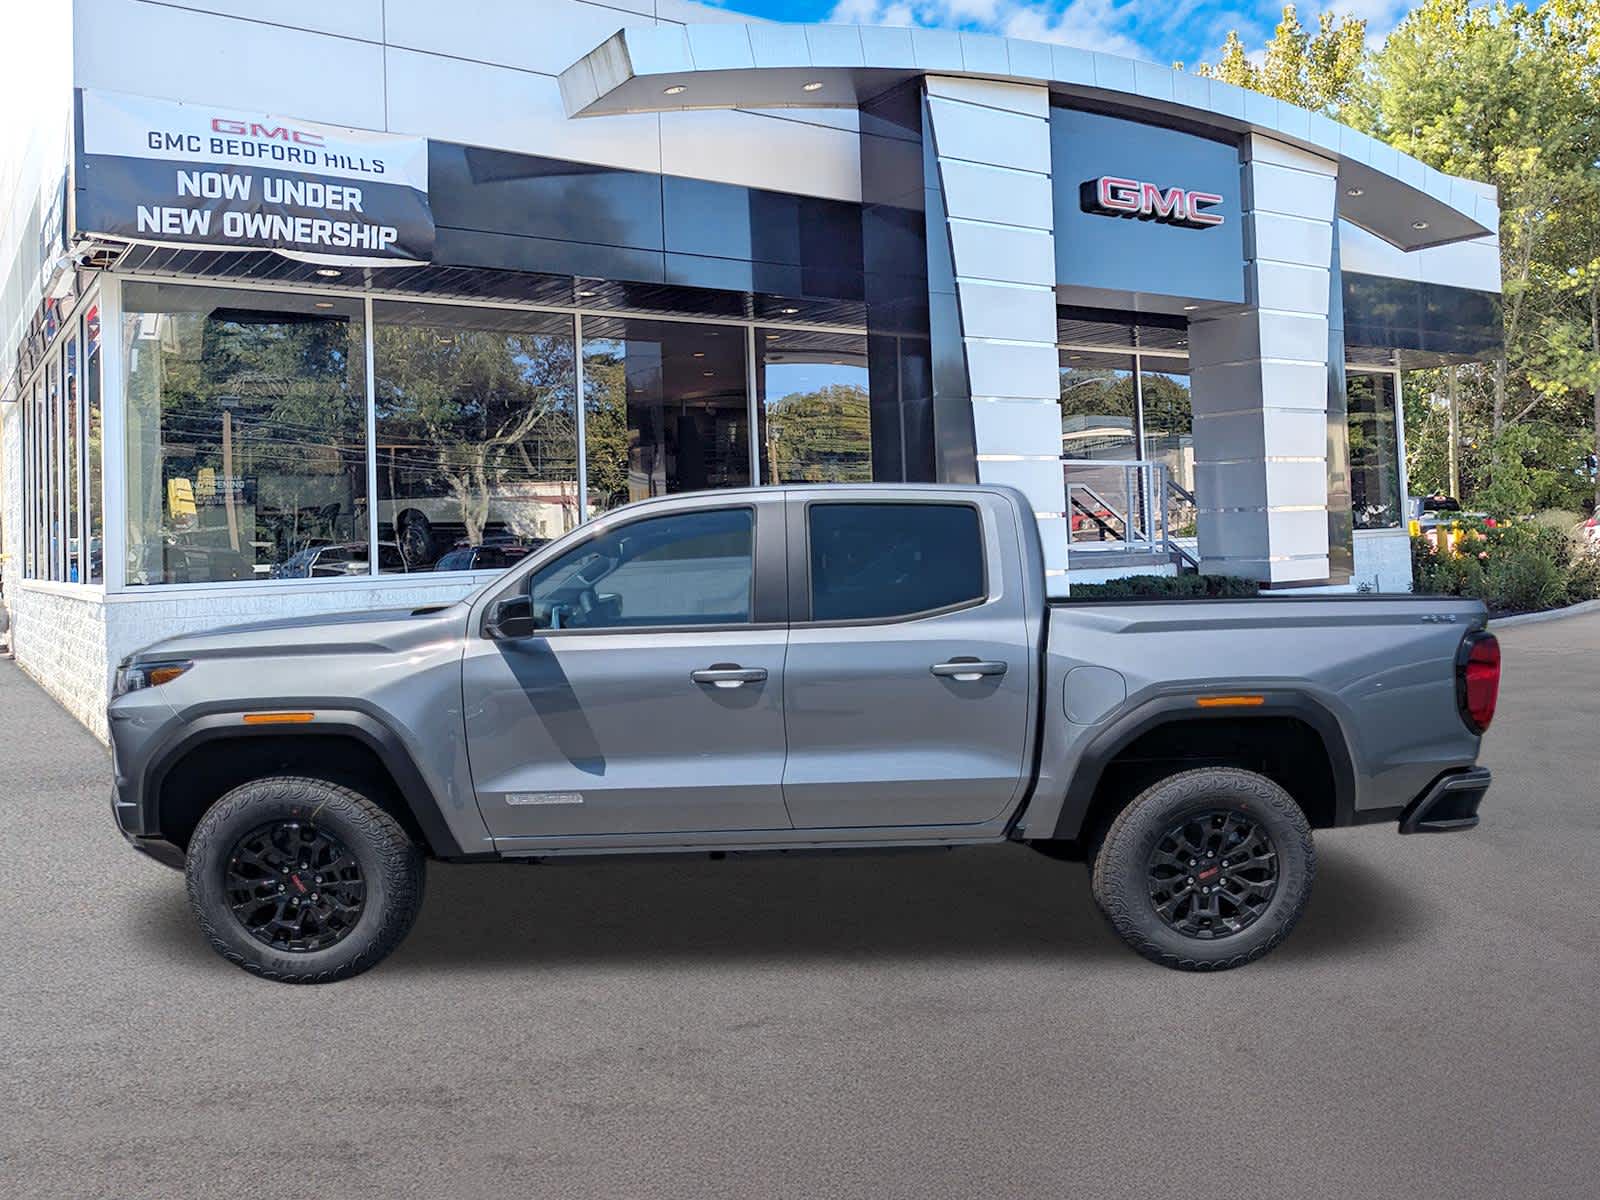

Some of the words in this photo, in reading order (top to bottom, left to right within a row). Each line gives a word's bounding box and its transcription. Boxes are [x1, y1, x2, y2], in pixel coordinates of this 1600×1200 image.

[148, 131, 201, 153] GMC
[210, 138, 317, 165] BEDFORD
[325, 153, 385, 174] HILLS
[210, 118, 326, 147] GMC
[177, 170, 252, 201] NOW
[263, 177, 363, 213] UNDER
[1096, 175, 1225, 224] GMC
[136, 205, 212, 236] NEW
[223, 211, 398, 250] OWNERSHIP
